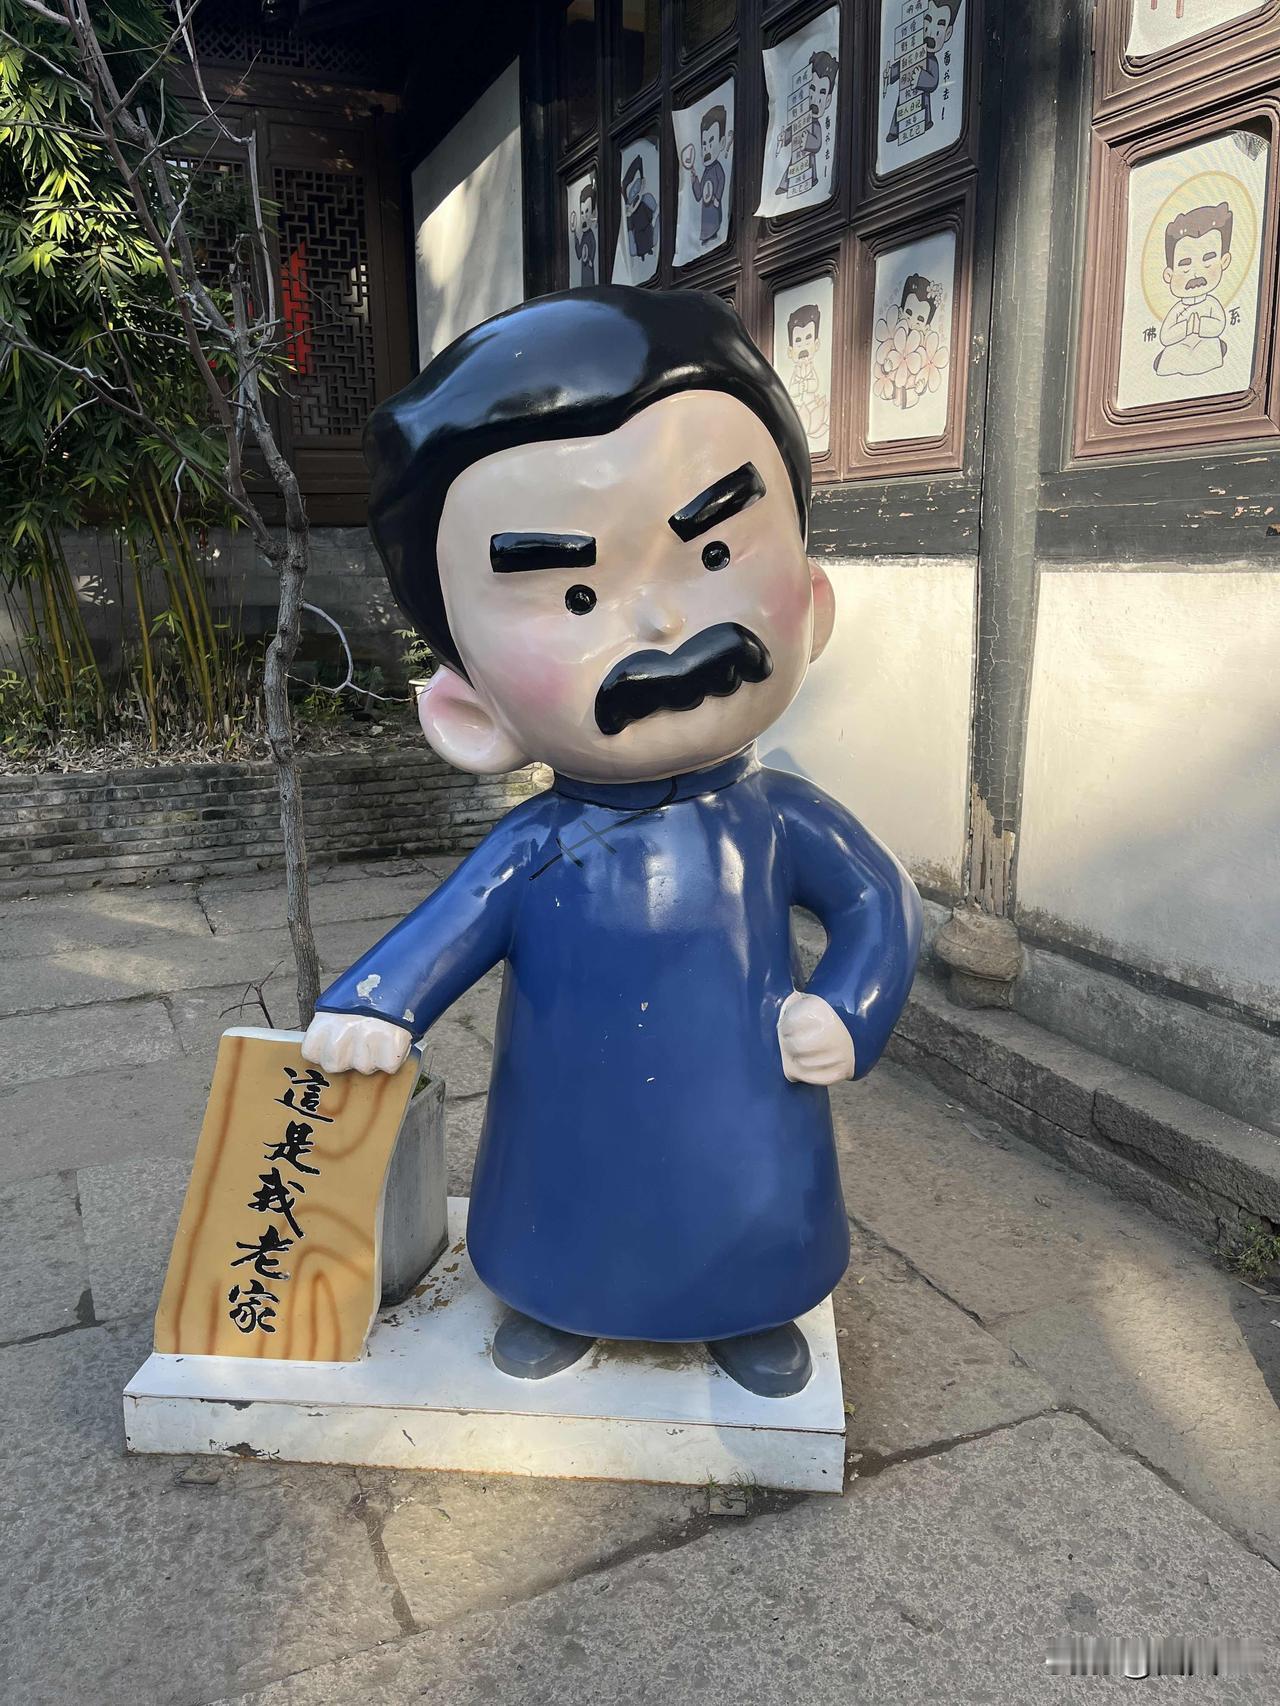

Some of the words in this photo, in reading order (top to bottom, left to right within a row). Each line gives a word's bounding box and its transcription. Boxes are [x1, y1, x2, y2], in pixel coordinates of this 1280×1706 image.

[229, 1067, 334, 1334] 這是我老家
